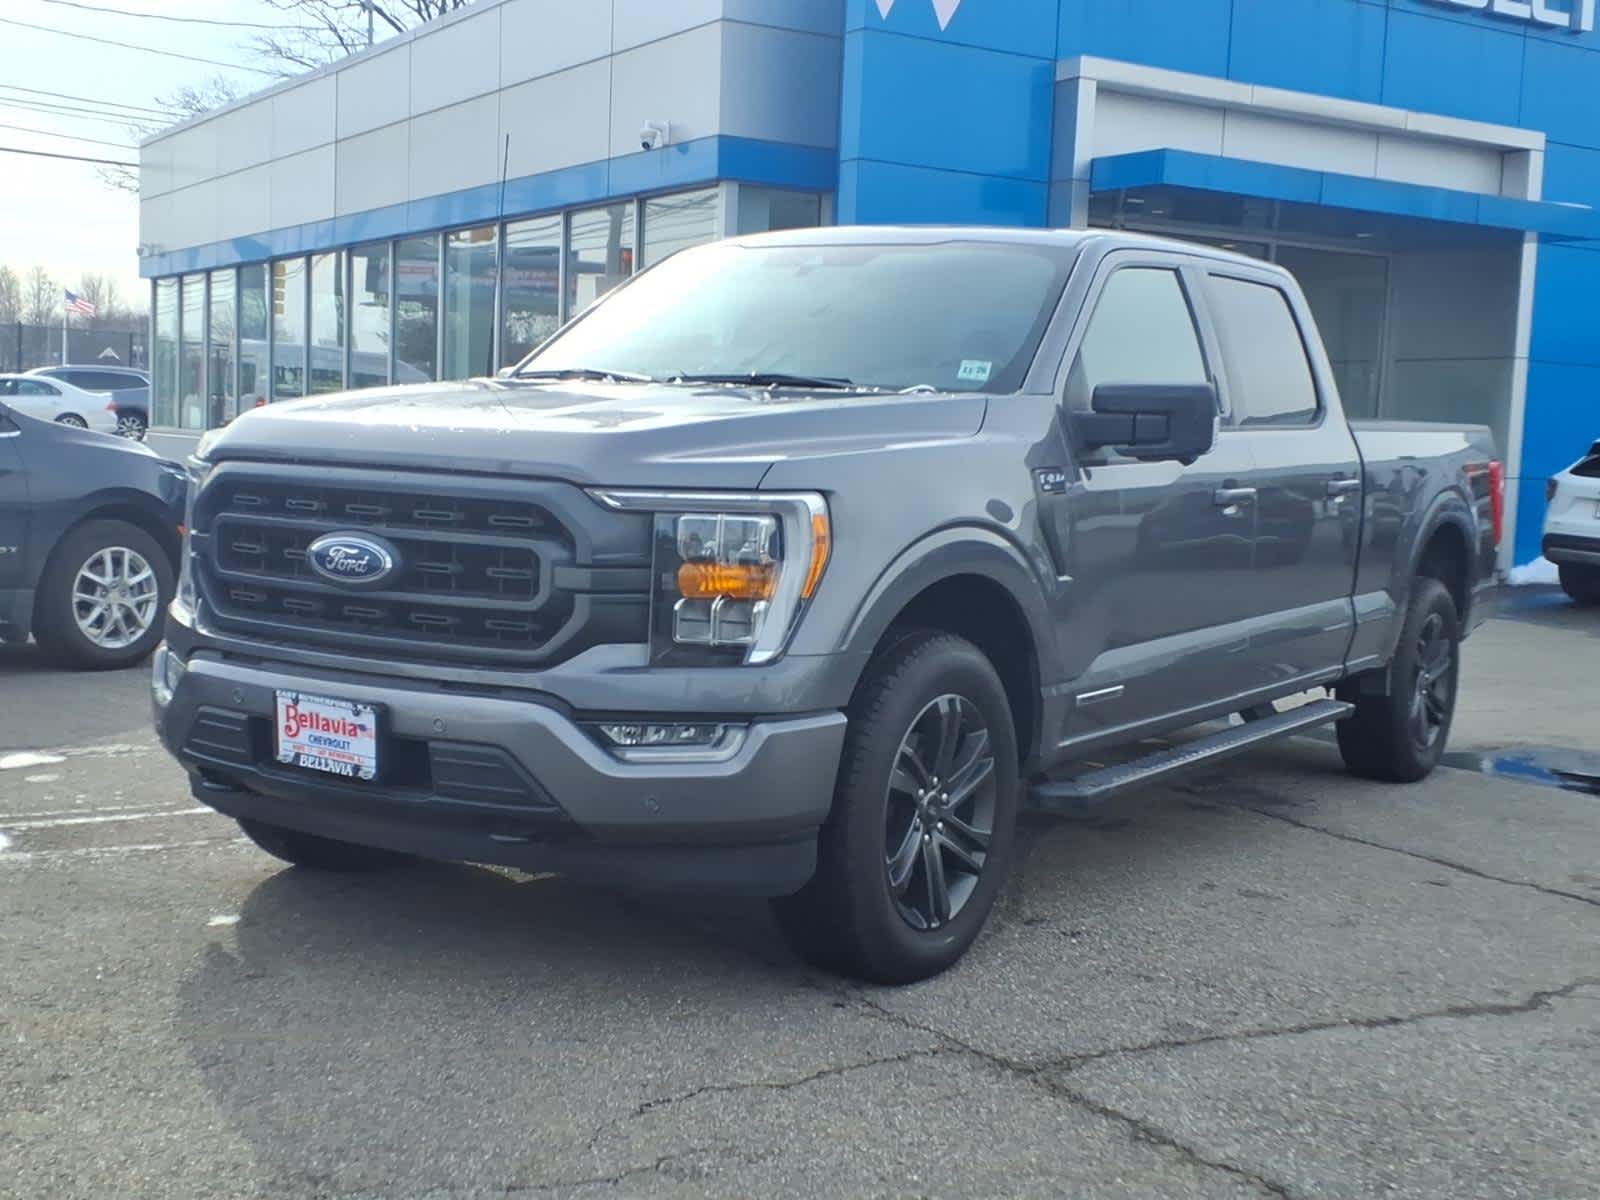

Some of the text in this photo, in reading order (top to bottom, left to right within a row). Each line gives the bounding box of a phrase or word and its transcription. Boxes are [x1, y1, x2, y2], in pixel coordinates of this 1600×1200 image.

[325, 546, 370, 573] Ford
[284, 703, 359, 738] Bellavia
[299, 754, 353, 777] BELLAVIA
